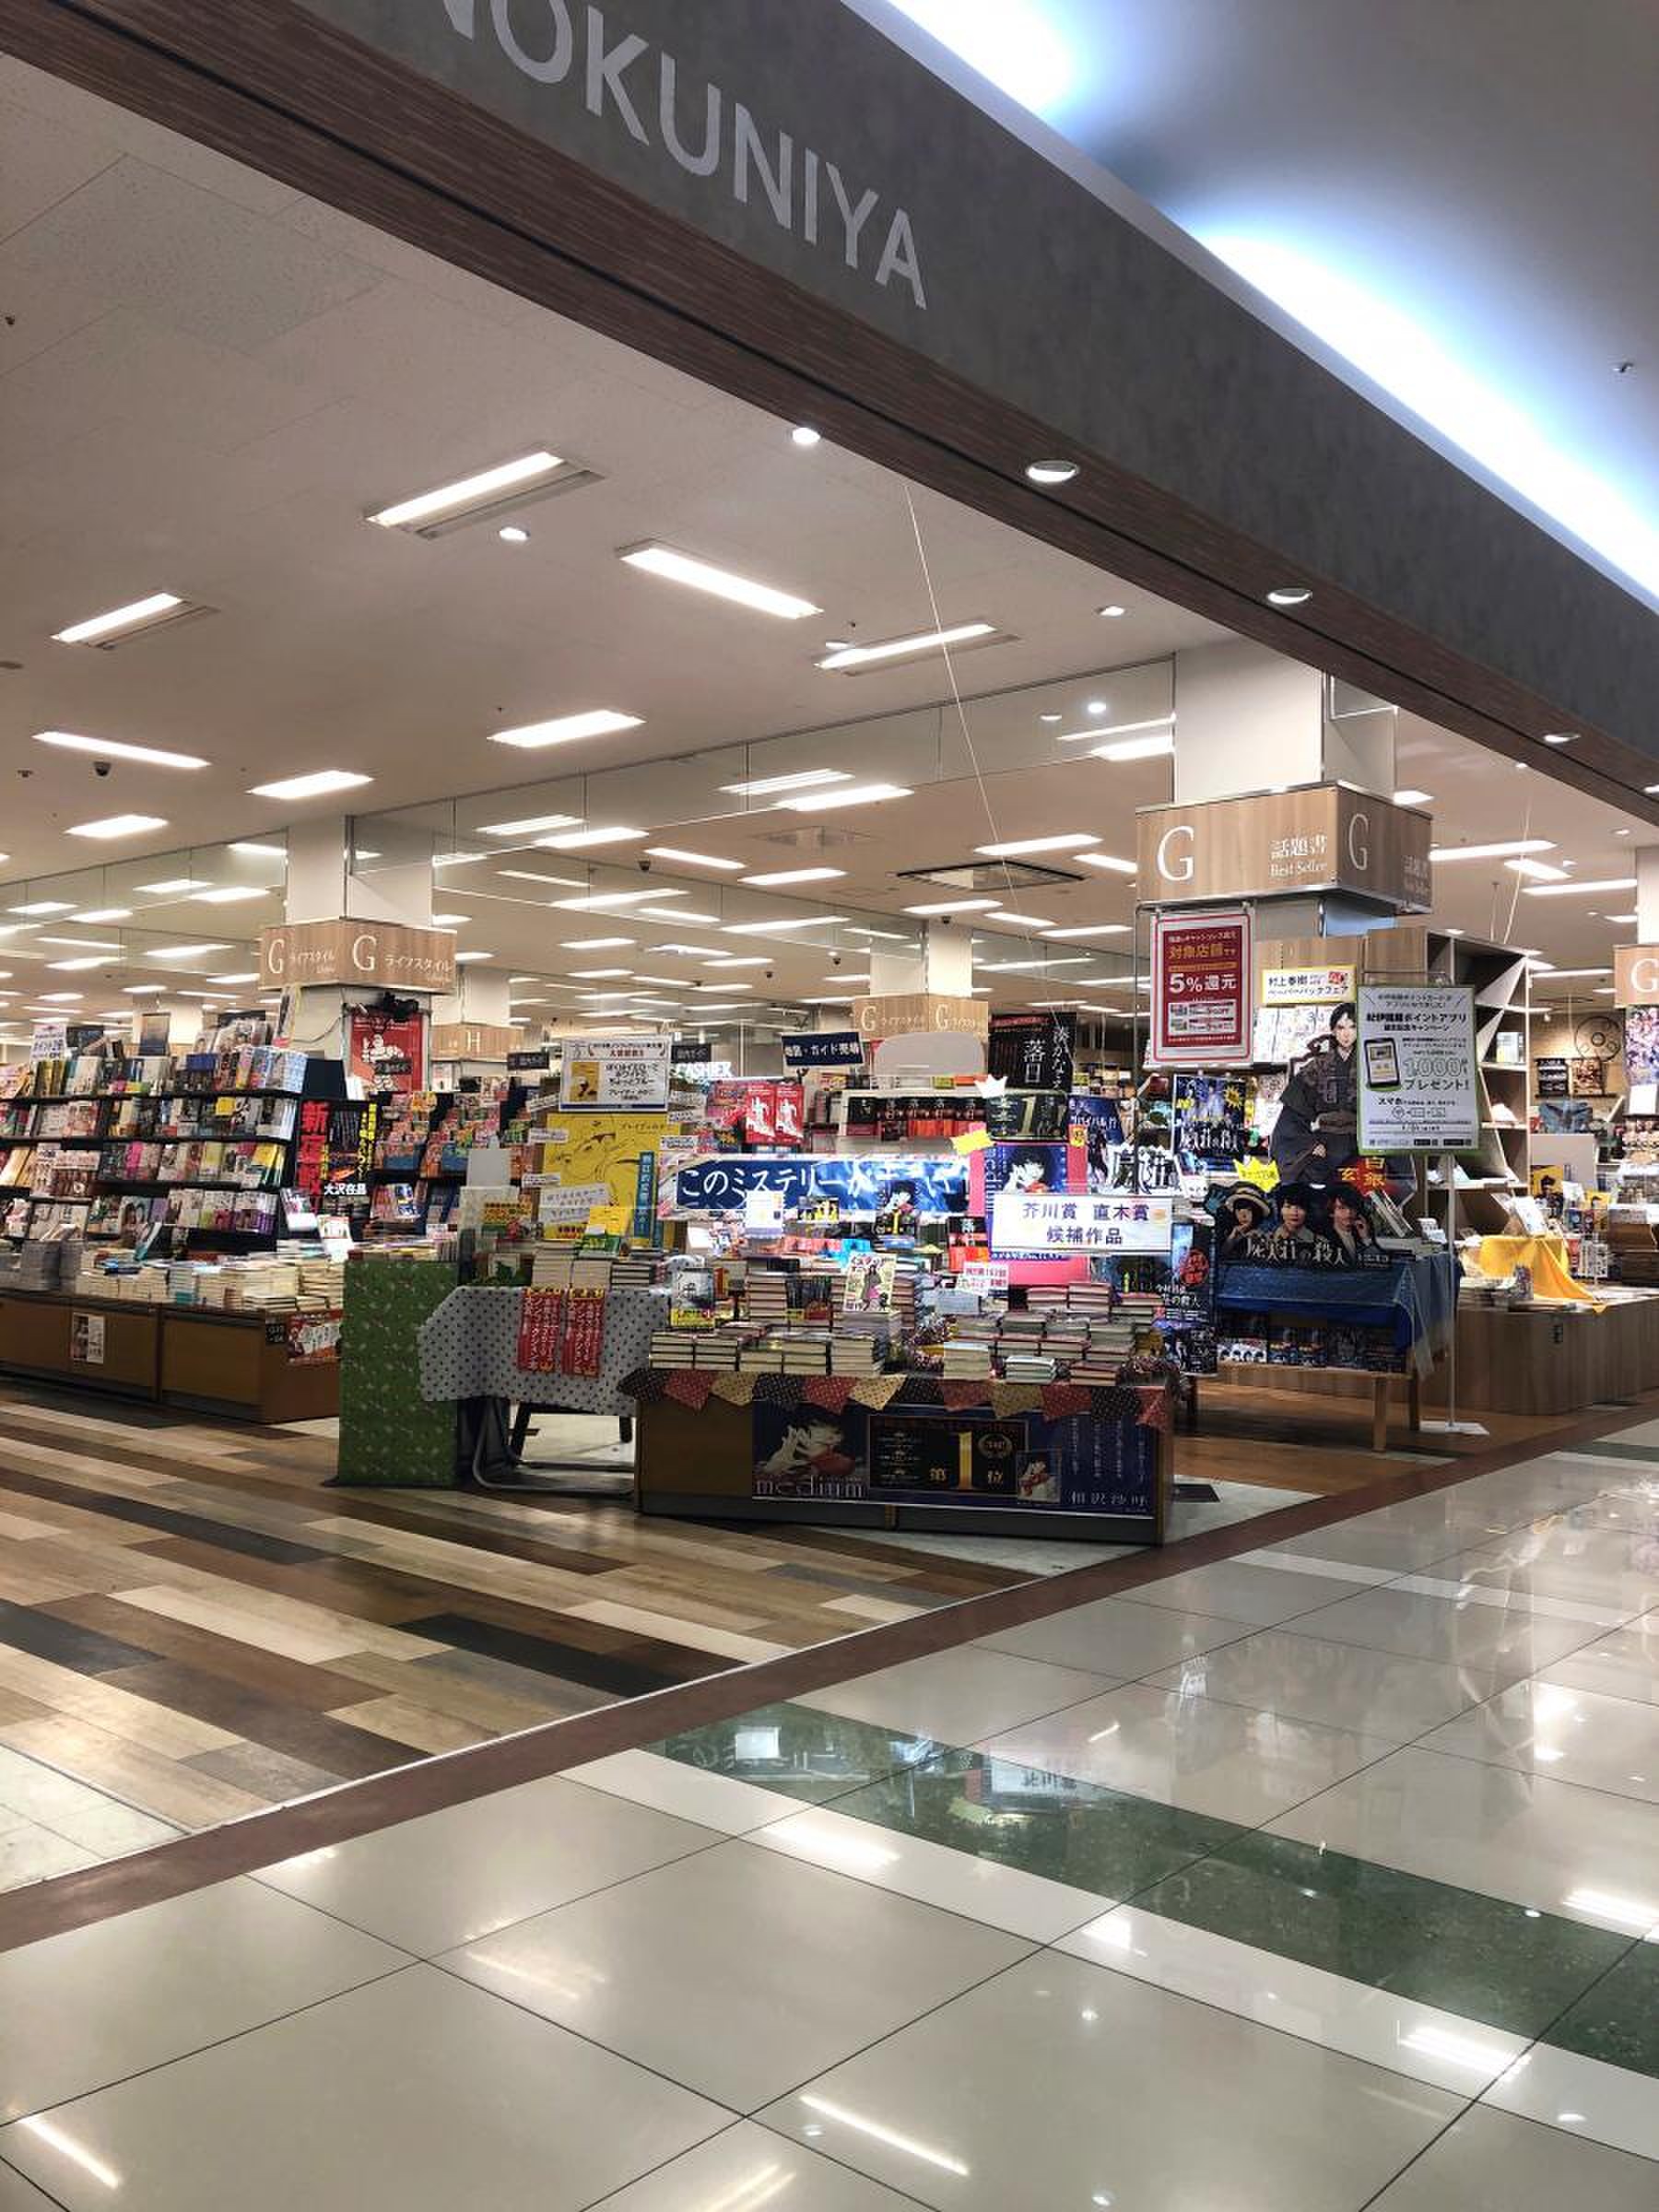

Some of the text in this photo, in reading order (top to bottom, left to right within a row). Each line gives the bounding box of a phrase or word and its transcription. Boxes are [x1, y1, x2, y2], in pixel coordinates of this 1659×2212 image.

[1157, 826, 1194, 881] G
[1348, 813, 1370, 871] G
[268, 938, 285, 974] G
[353, 935, 377, 971] G
[1630, 958, 1659, 994] G
[860, 1005, 877, 1032] G
[1023, 1203, 1150, 1221] 芥川賞 直木賞
[1046, 1226, 1123, 1244] 候補作品
